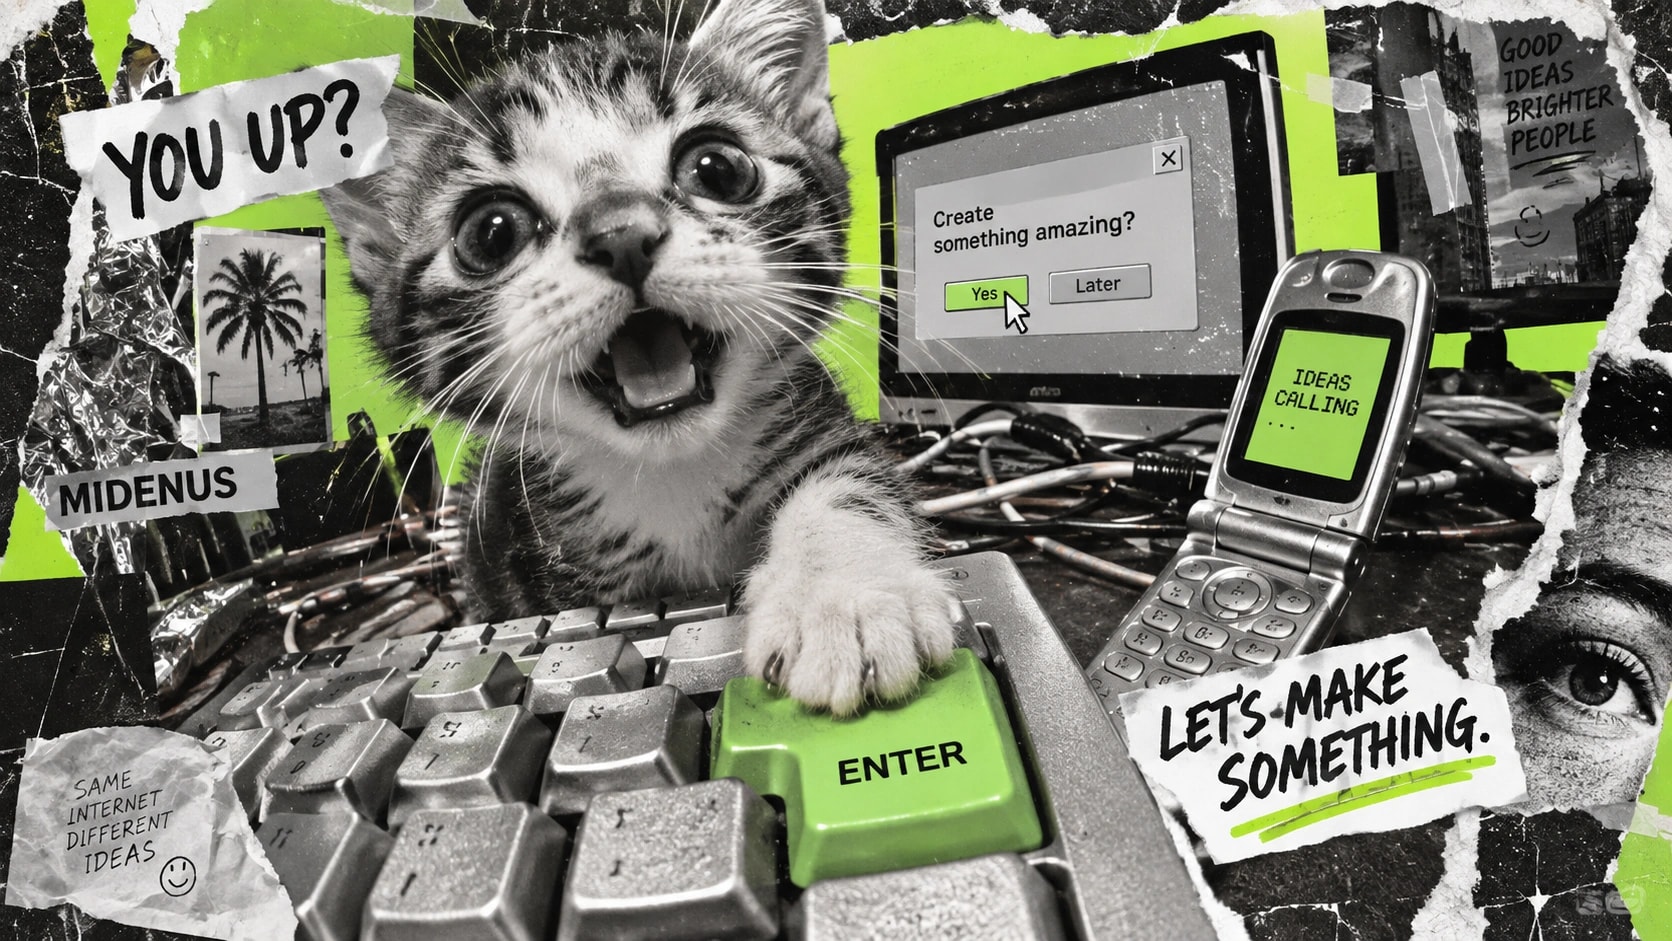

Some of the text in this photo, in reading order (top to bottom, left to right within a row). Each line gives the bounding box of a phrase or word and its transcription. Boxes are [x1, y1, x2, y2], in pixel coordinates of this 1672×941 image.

[1500, 32, 1562, 63] GOOD
[1503, 60, 1574, 94] IDEAS
[1505, 84, 1614, 125] BRIGHTER
[102, 78, 360, 220] YOU UP?
[1511, 118, 1597, 156] PEOPLE
[933, 206, 995, 228] Create
[933, 210, 1136, 254] something amazing?
[971, 286, 998, 302] Yes
[1075, 277, 1121, 294] Later
[1292, 368, 1352, 392] IDEAS
[1274, 389, 1360, 417] CALLING
[59, 465, 238, 517] MIDENUS
[1160, 653, 1409, 762] LET'S MAKE
[838, 740, 968, 786] ENTER
[1217, 697, 1490, 812] SOMETHING.
[74, 769, 132, 801] SAME
[67, 789, 163, 826] INTERNET
[66, 810, 174, 851] DIFFERENT
[84, 839, 156, 875] IDEAS
